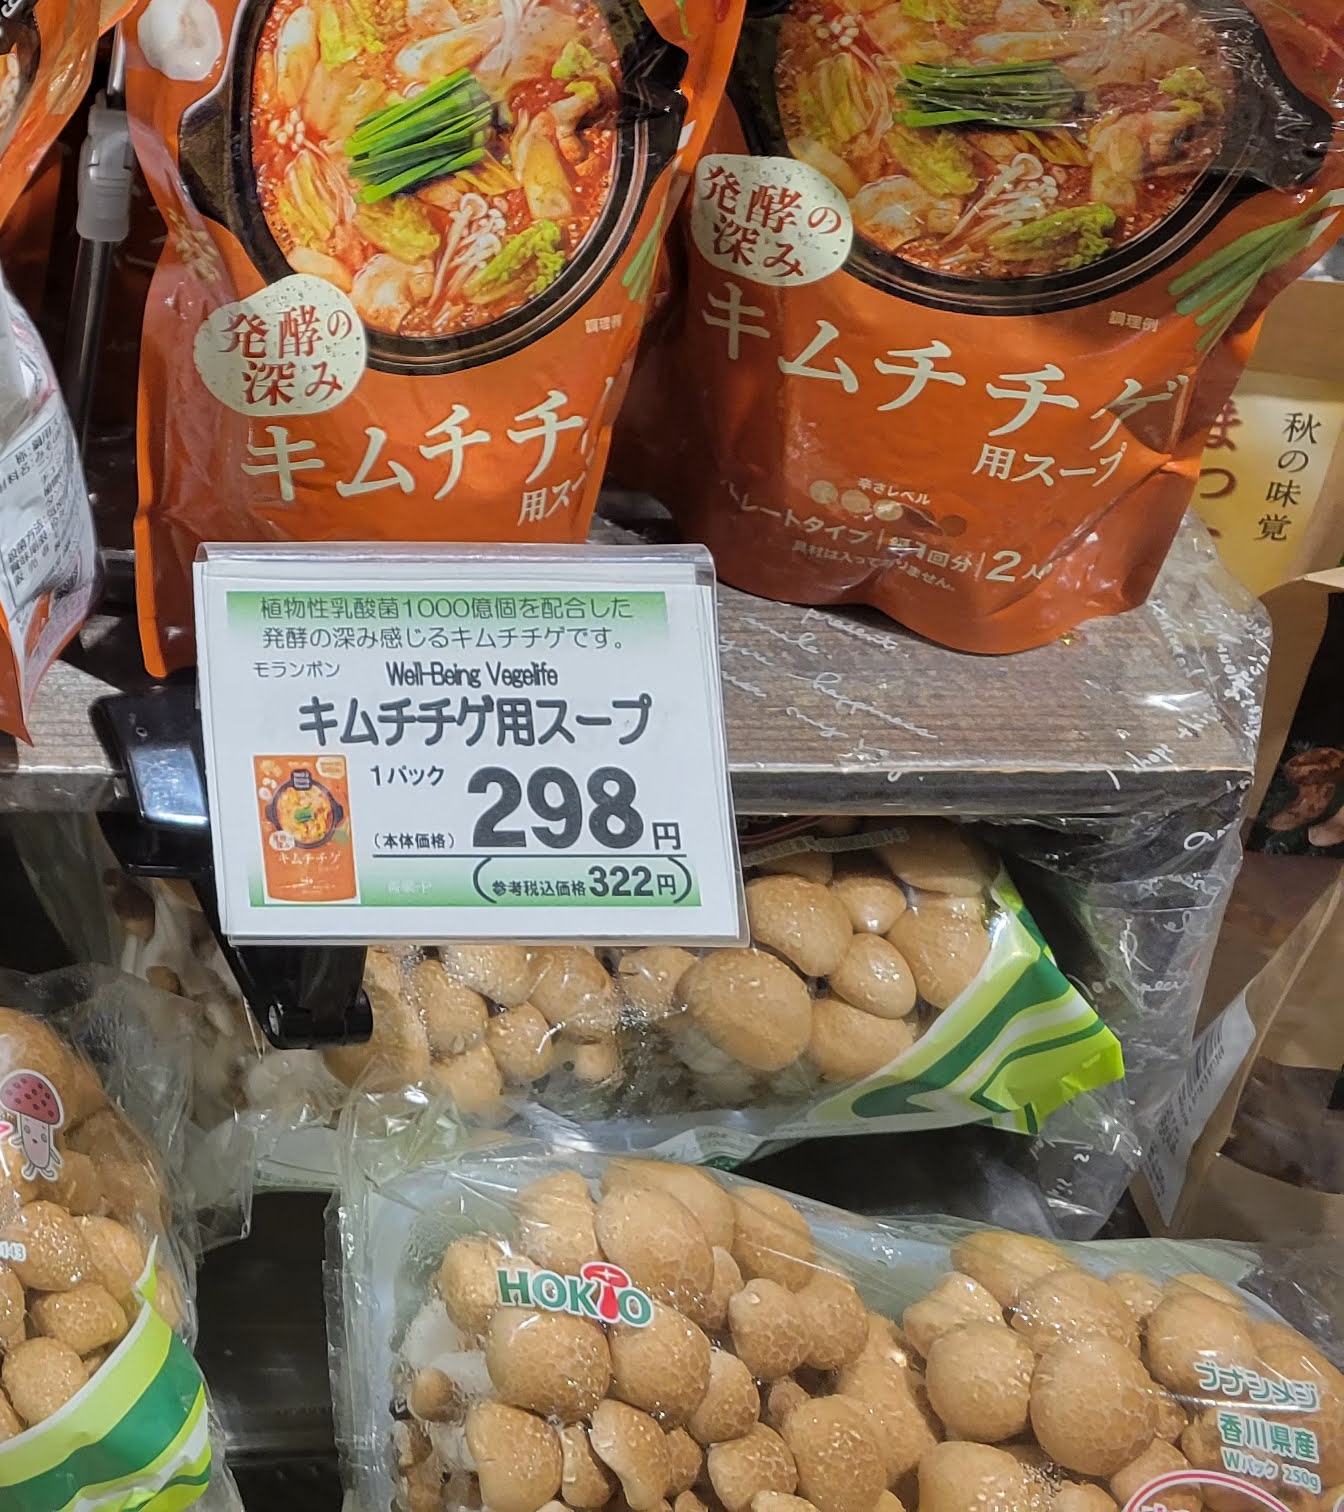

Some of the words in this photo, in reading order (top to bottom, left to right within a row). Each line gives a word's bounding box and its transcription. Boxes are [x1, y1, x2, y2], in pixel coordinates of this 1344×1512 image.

[703, 167, 842, 235] 発酵の
[712, 217, 804, 278] 深み
[219, 306, 352, 360] 発酵の
[242, 360, 344, 406] 深み
[701, 282, 1190, 451] キムチチゲ
[972, 441, 1129, 488] 用スープ
[1254, 412, 1322, 541] 秋の味覚
[858, 477, 931, 506] 辛さレベル
[261, 596, 634, 621] 植物性乳酸菌1000億個を配合した
[263, 626, 625, 650] 発酵の深み感じるキムチチゲです。
[252, 660, 341, 680] モランボン
[386, 661, 481, 688] Well-Being
[485, 661, 558, 688] Vegelife
[298, 695, 652, 746] キムチチゲ用スープ
[370, 764, 445, 787] 1パック
[497, 1262, 653, 1327] HOKTO
[1195, 1362, 1318, 1410] ブナシメジ
[1219, 1413, 1317, 1462] 香川県産
[1283, 1467, 1320, 1493] 250g
